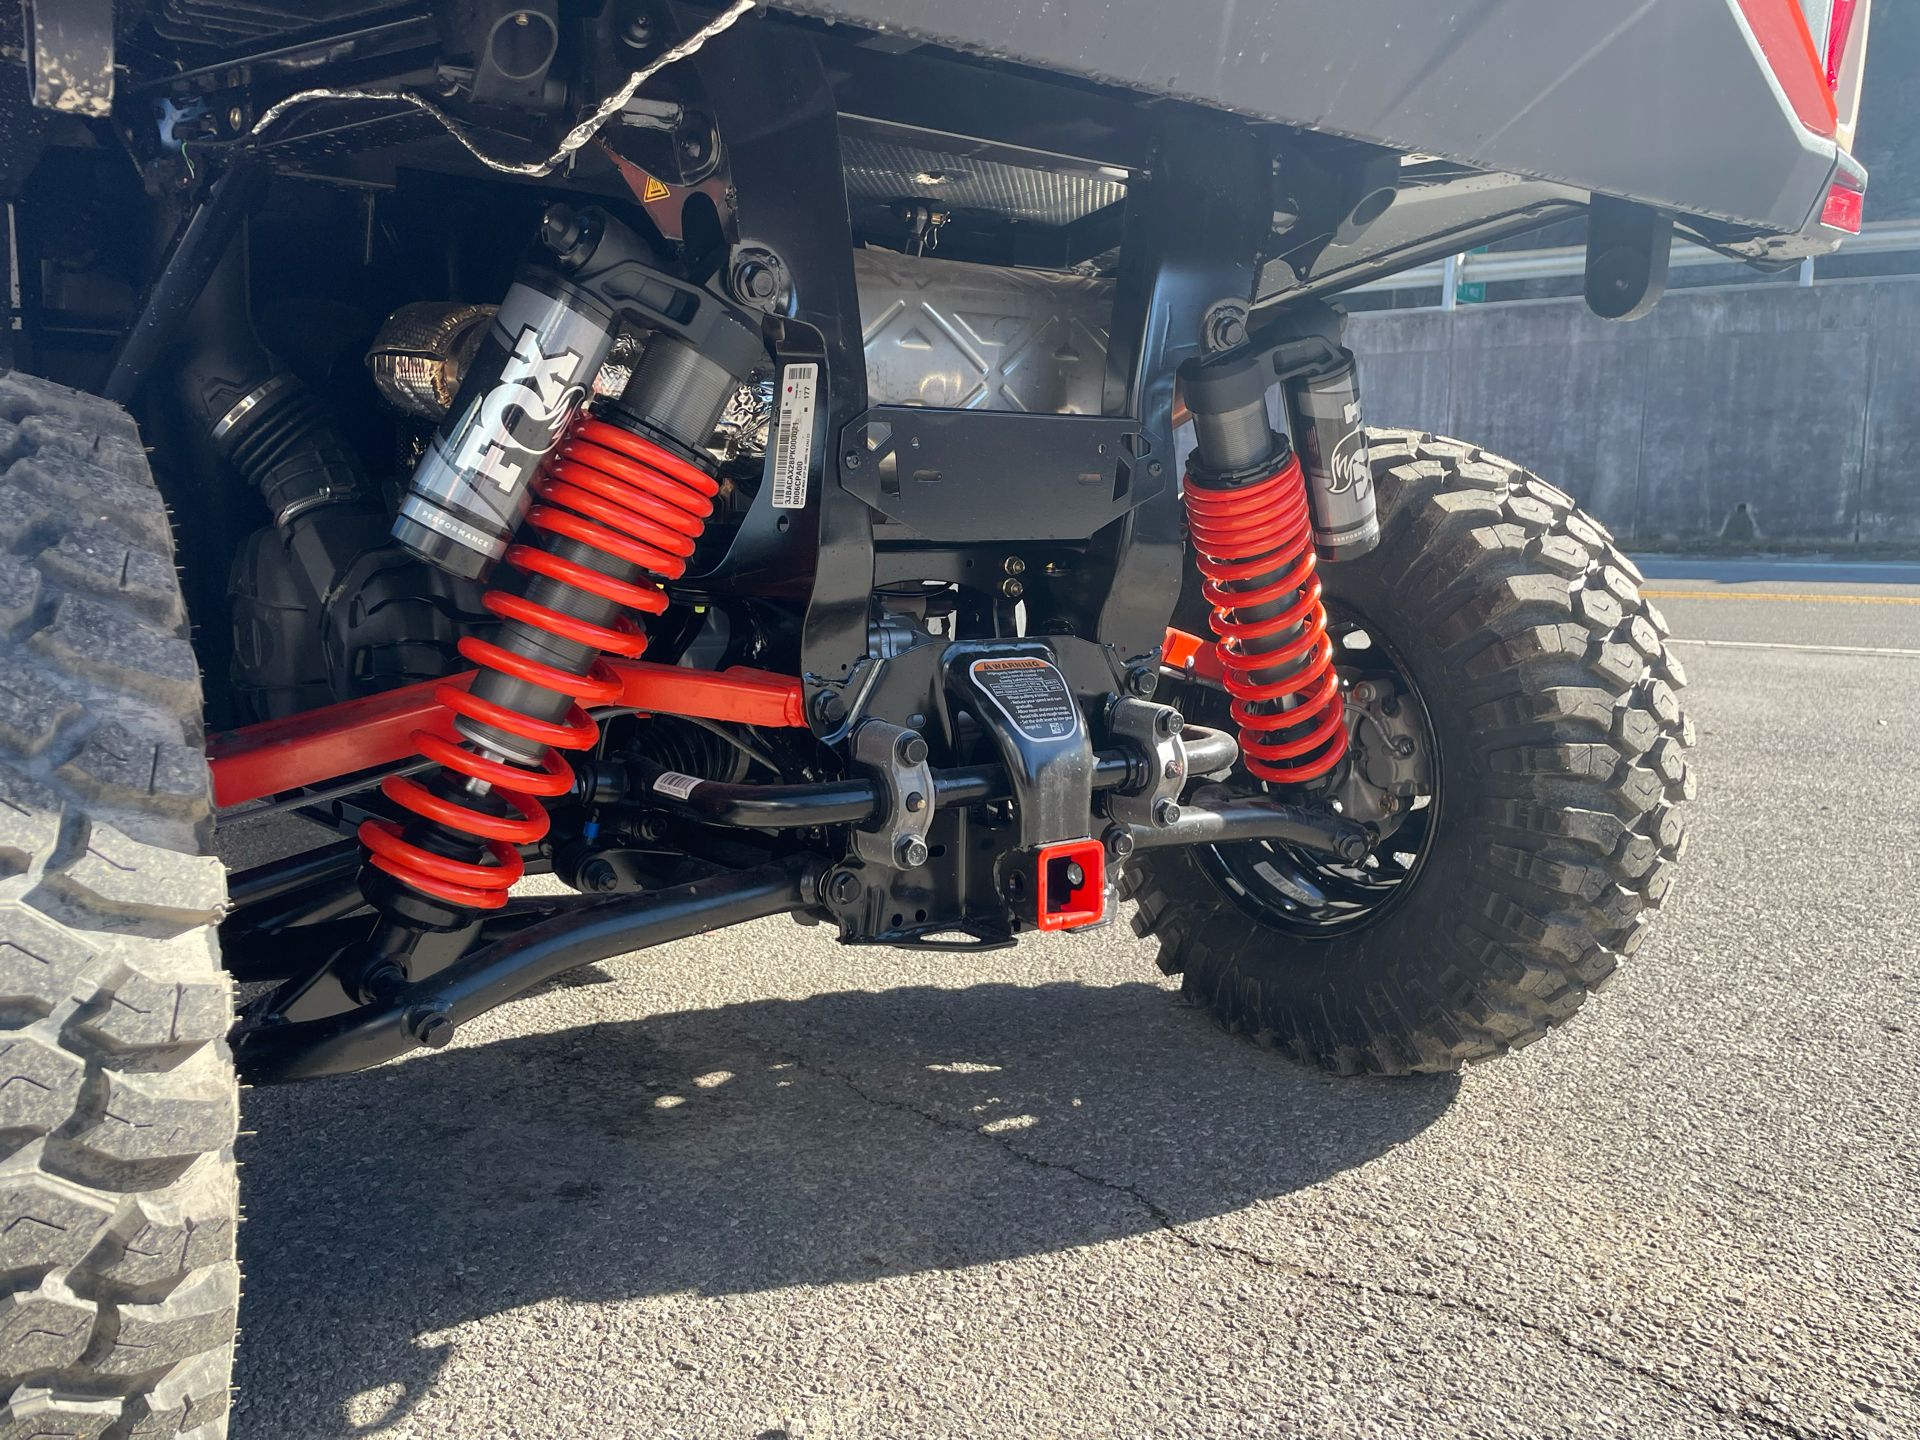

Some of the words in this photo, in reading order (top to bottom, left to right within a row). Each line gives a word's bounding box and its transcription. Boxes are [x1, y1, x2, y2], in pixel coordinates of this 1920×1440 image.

[454, 327, 585, 494] FOX
[422, 510, 489, 548] PERFORMANCE
[992, 661, 1040, 670] WARNING
